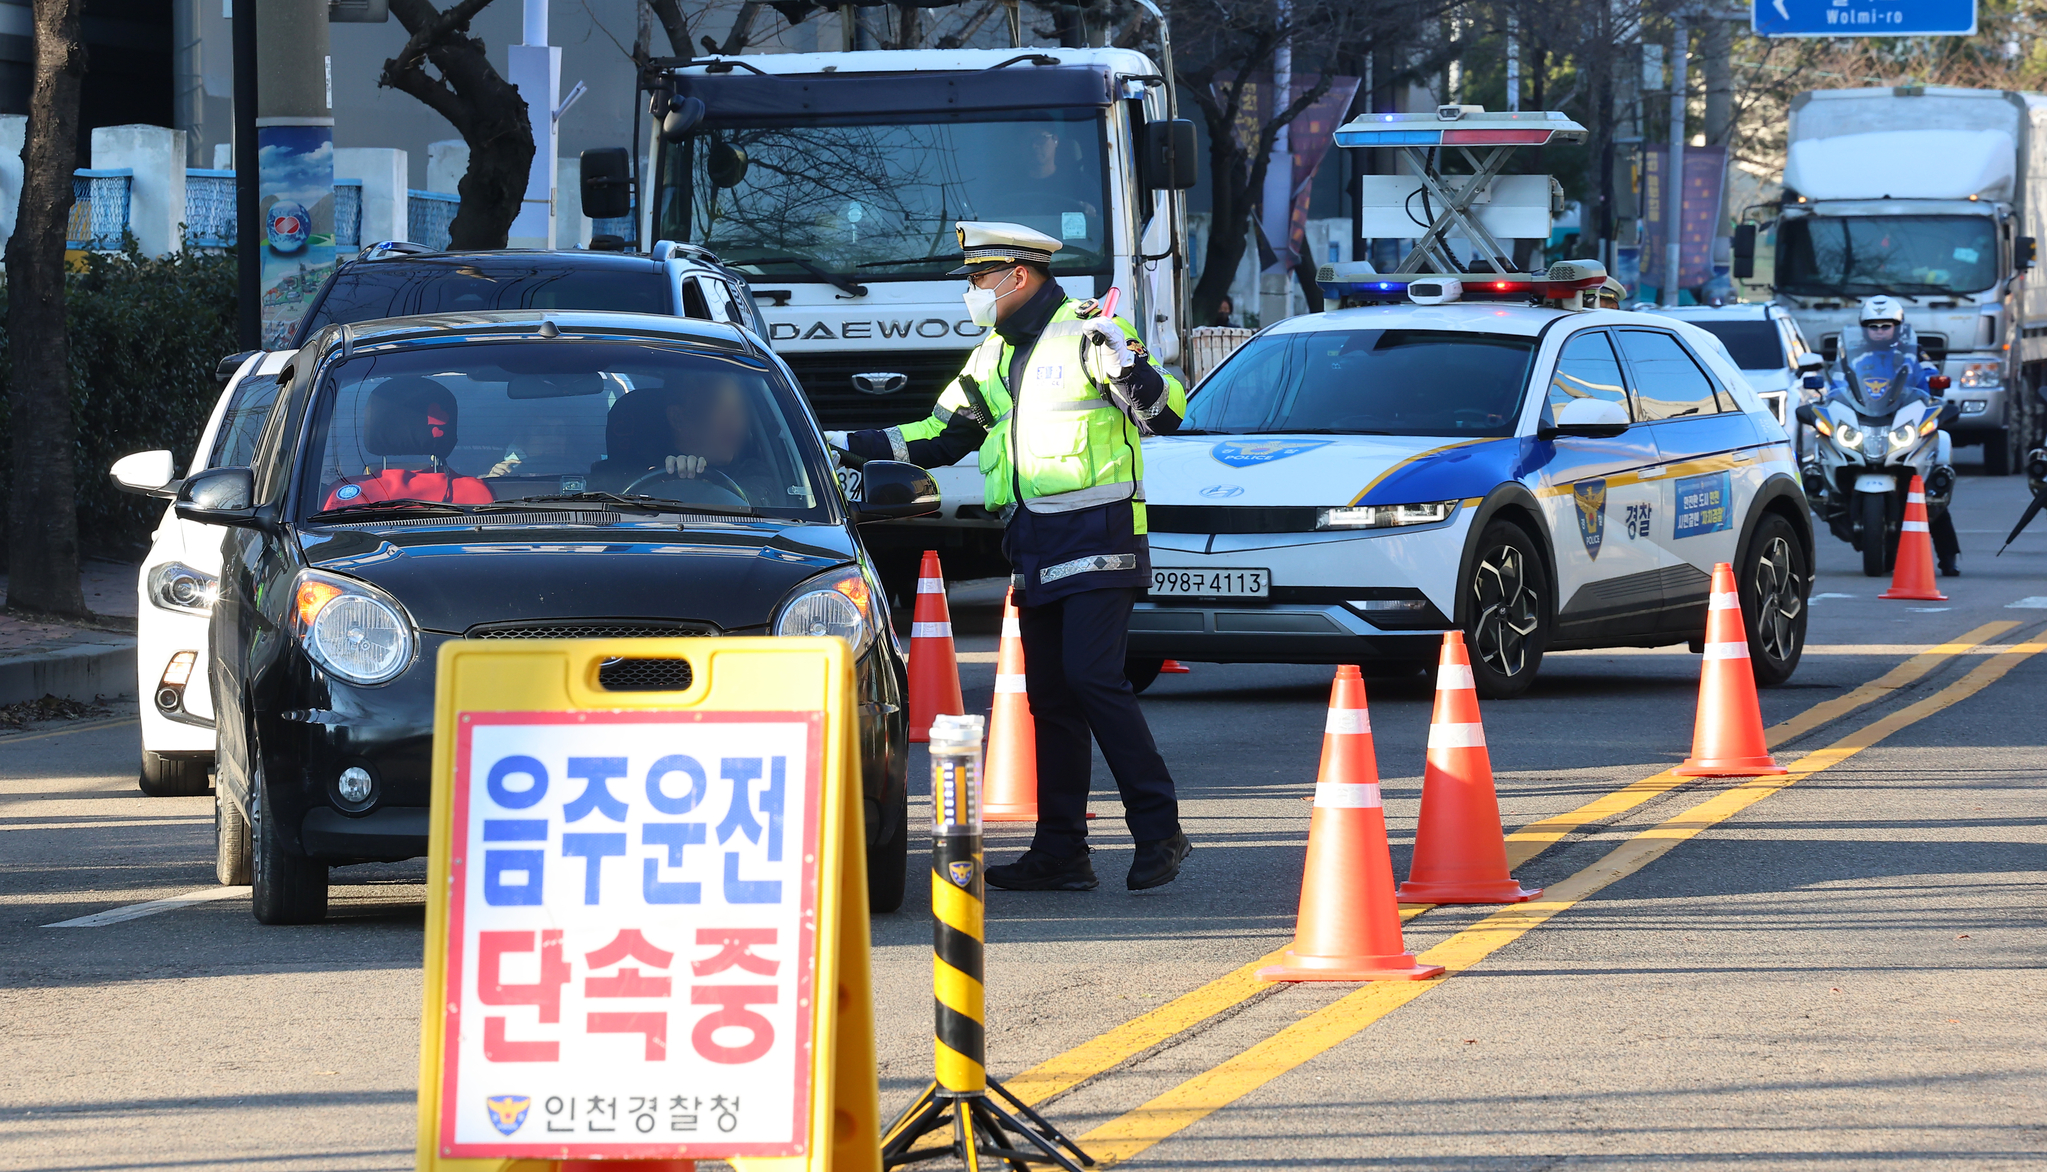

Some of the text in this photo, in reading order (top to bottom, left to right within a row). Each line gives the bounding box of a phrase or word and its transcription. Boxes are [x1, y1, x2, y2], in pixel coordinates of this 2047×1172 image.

[1826, 8, 1903, 25] Wolmi-ro
[769, 318, 987, 340] DAEWOO
[1698, 492, 1709, 507] 도시
[1625, 502, 1652, 540] 경찰
[1586, 534, 1601, 546] POLICE
[482, 754, 787, 906] 음주운전
[477, 928, 781, 1065] 단속중
[545, 1094, 740, 1133] 인천경찰청
